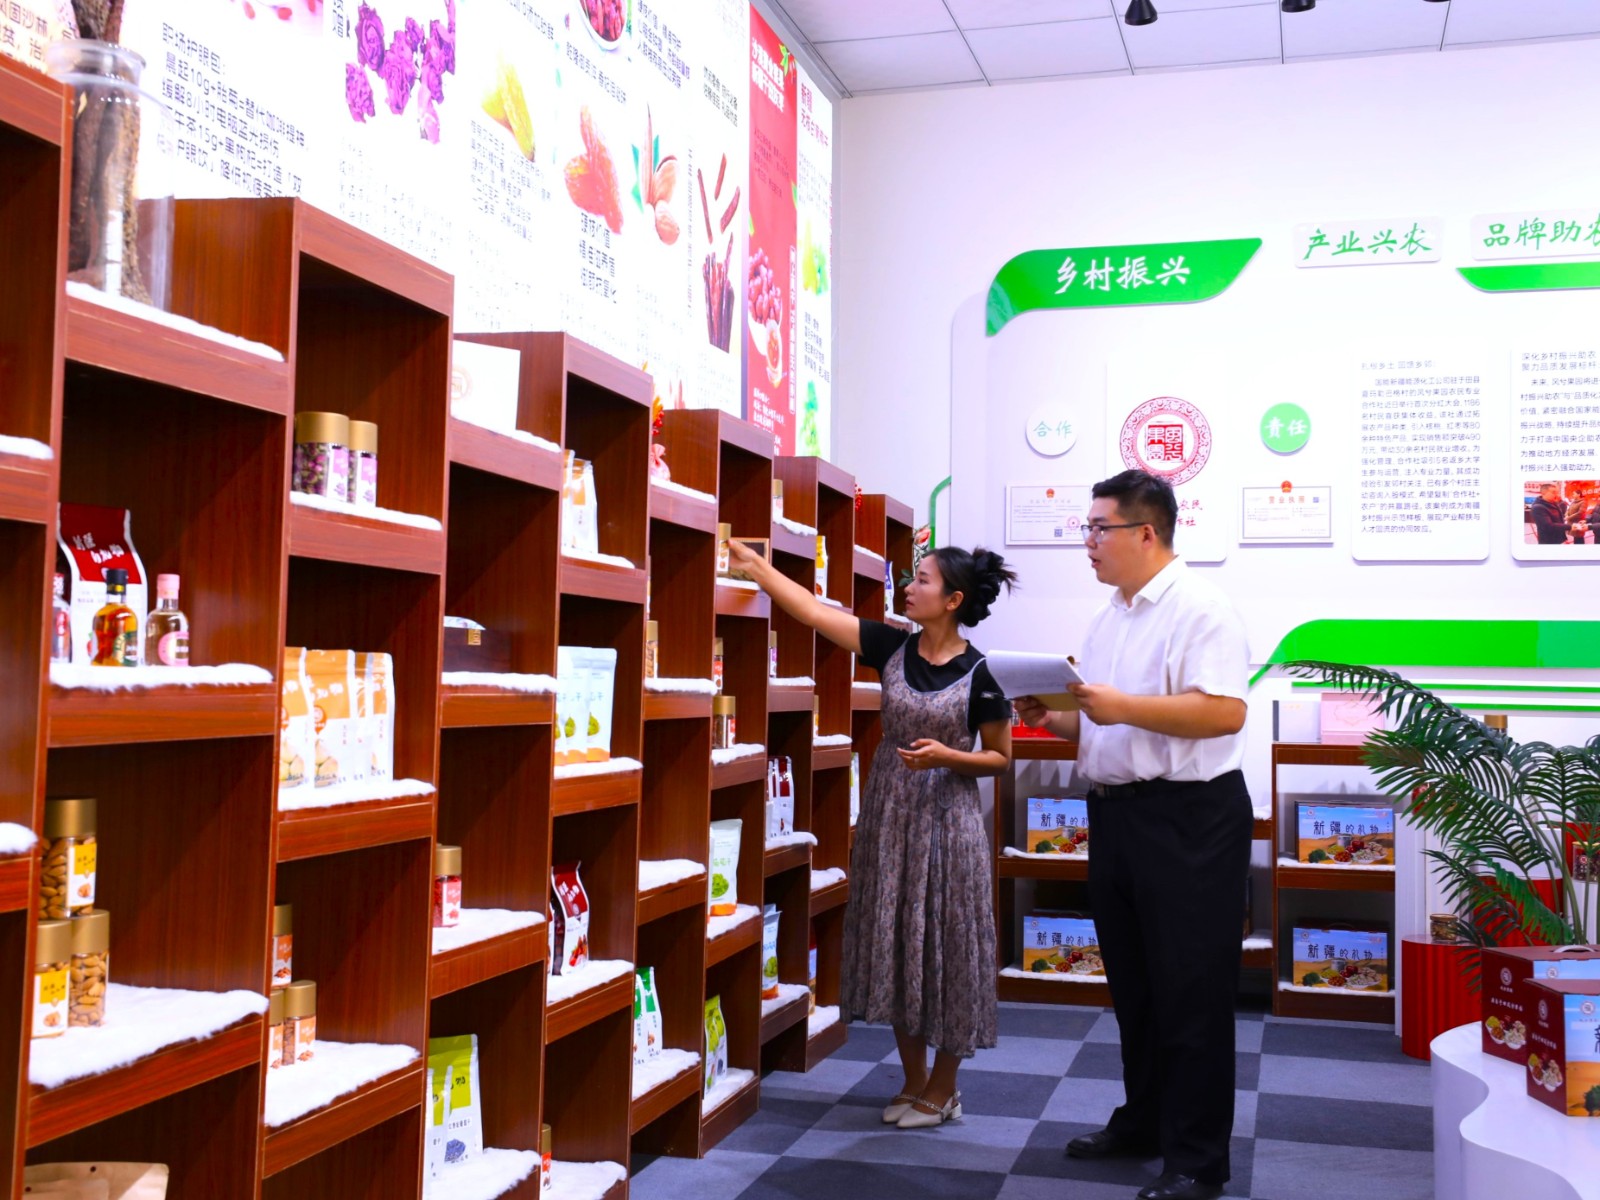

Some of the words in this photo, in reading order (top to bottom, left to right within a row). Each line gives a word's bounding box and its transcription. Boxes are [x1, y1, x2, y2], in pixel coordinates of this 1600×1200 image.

[1302, 222, 1433, 260] 产业兴农
[1054, 255, 1190, 294] 乡村振兴
[1033, 419, 1073, 439] 合作
[1040, 812, 1088, 828] 新疆的礼
[1313, 820, 1379, 836] 新疆的礼物
[1307, 943, 1373, 961] 新疆的礼物
